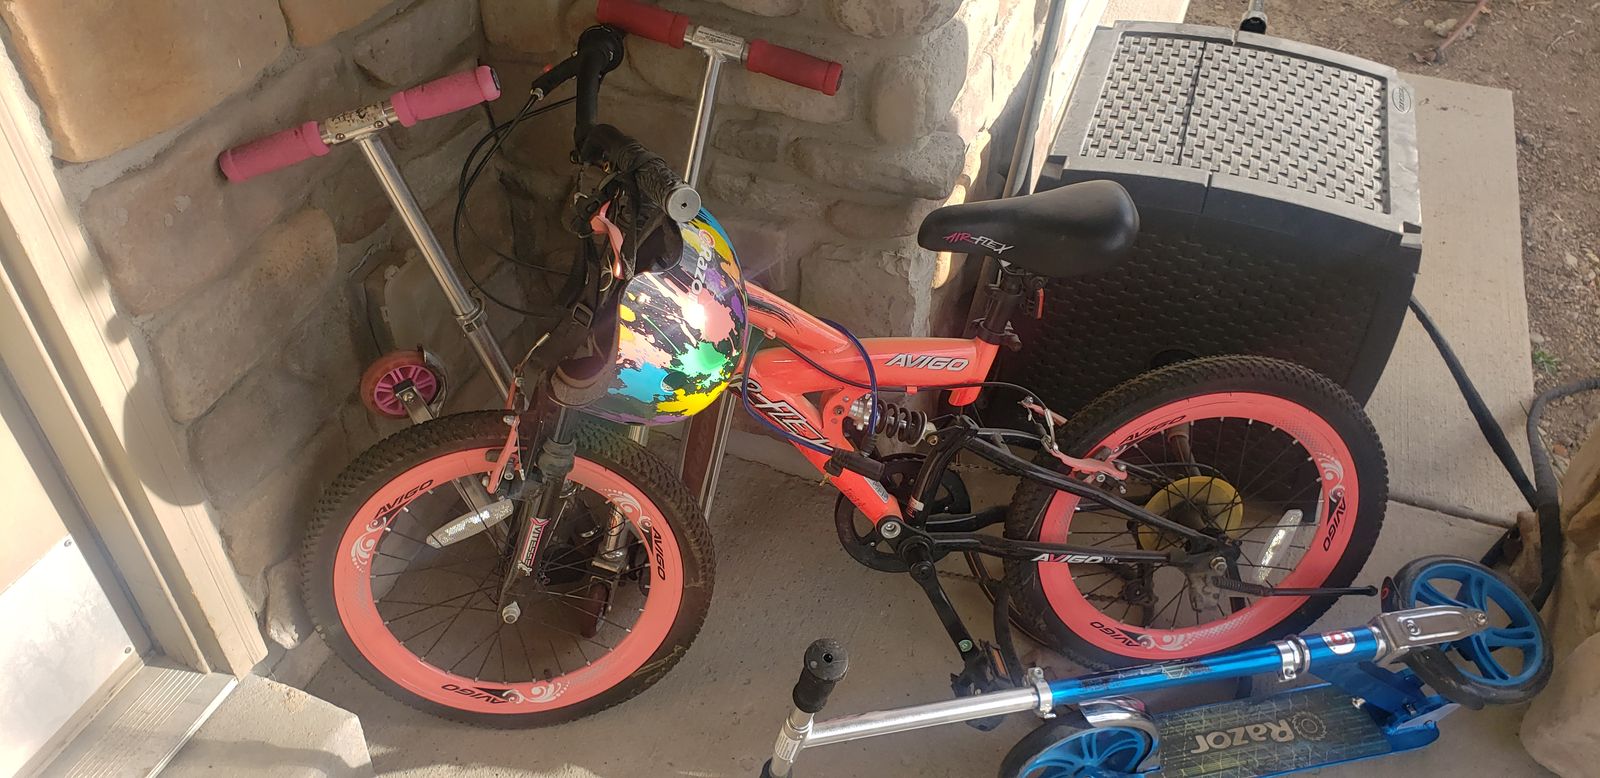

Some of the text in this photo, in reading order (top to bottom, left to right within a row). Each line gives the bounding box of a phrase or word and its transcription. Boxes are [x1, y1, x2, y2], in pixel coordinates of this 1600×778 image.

[943, 232, 1015, 254] AIR-FLEX
[884, 353, 969, 371] AVIGO
[1119, 415, 1187, 444] AVIGO
[374, 479, 434, 520] AVIGO
[1323, 496, 1346, 552] AVIGO
[524, 524, 544, 568] VITESSE
[652, 526, 666, 581] AVIGO
[1031, 553, 1103, 564] AVIGO
[1090, 621, 1140, 647] AVIGO
[441, 684, 508, 704] AVIGO
[1191, 719, 1294, 754] Razor
